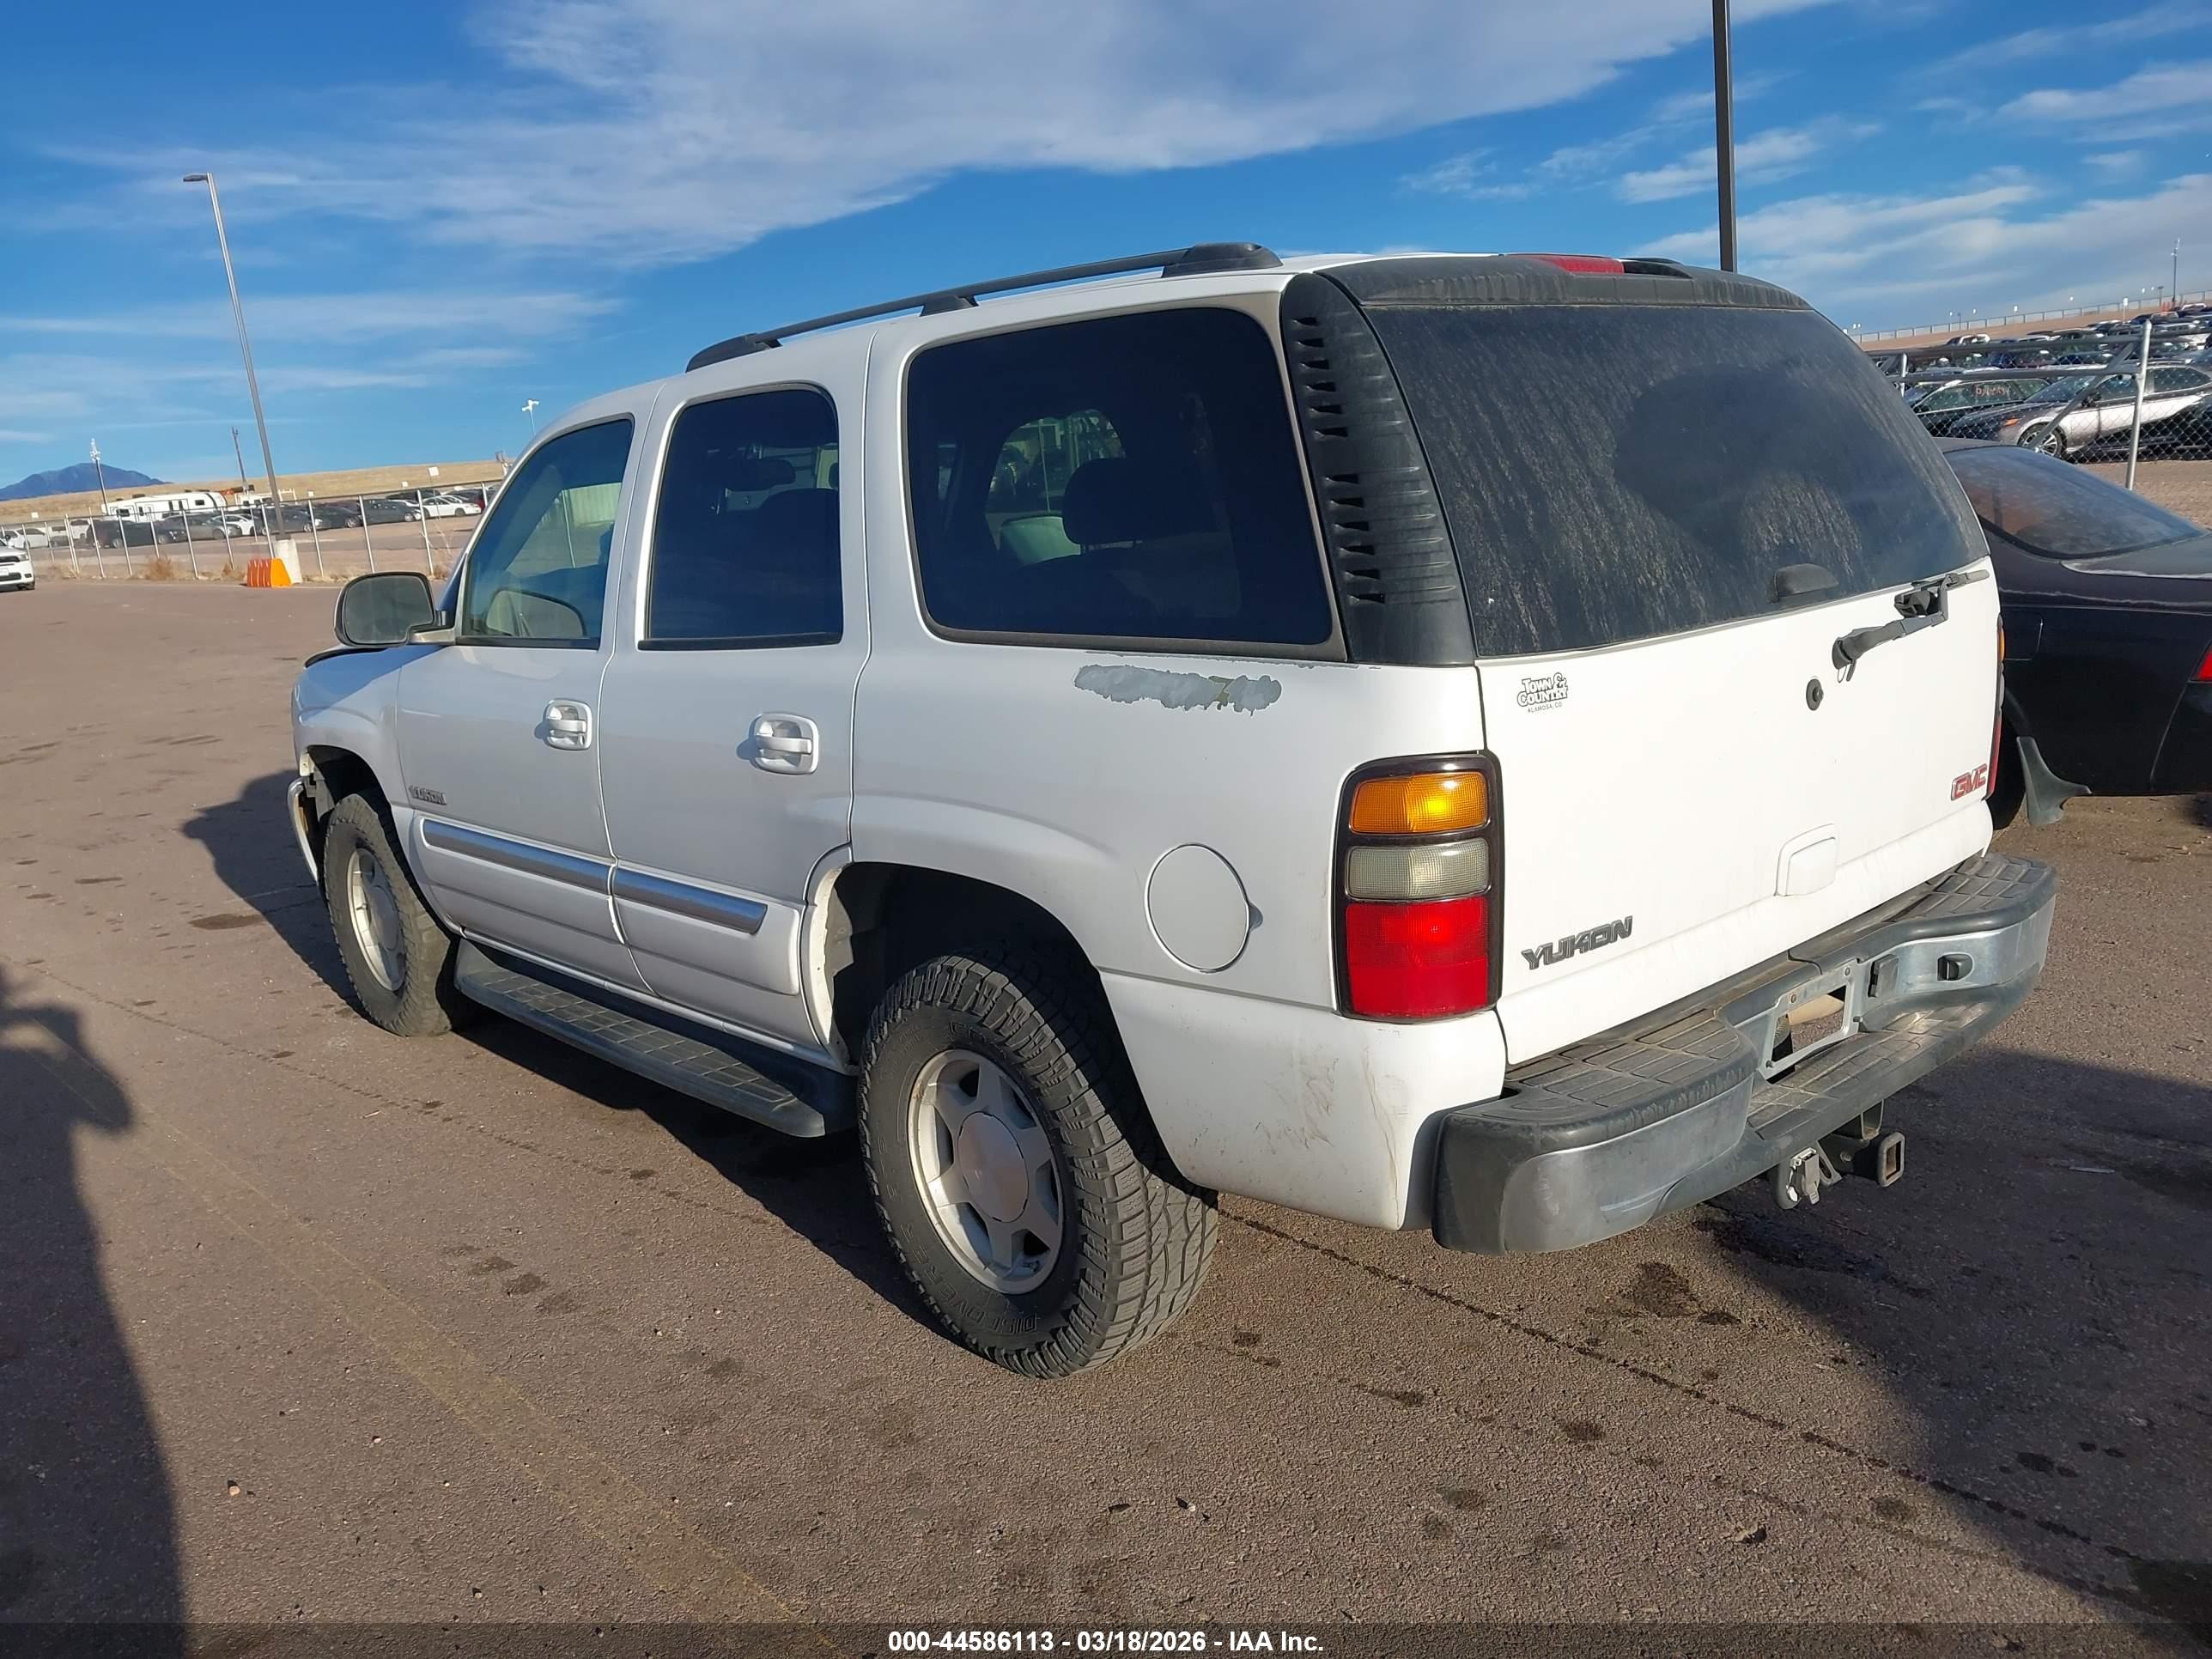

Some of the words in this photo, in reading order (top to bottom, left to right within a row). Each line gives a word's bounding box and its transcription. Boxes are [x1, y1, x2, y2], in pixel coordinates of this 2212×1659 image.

[1553, 672, 1568, 690] &
[1517, 685, 1569, 707] COUNTRY
[1951, 763, 1988, 801] GMC
[408, 785, 447, 805] YUKON
[1521, 915, 1633, 970] YUKON
